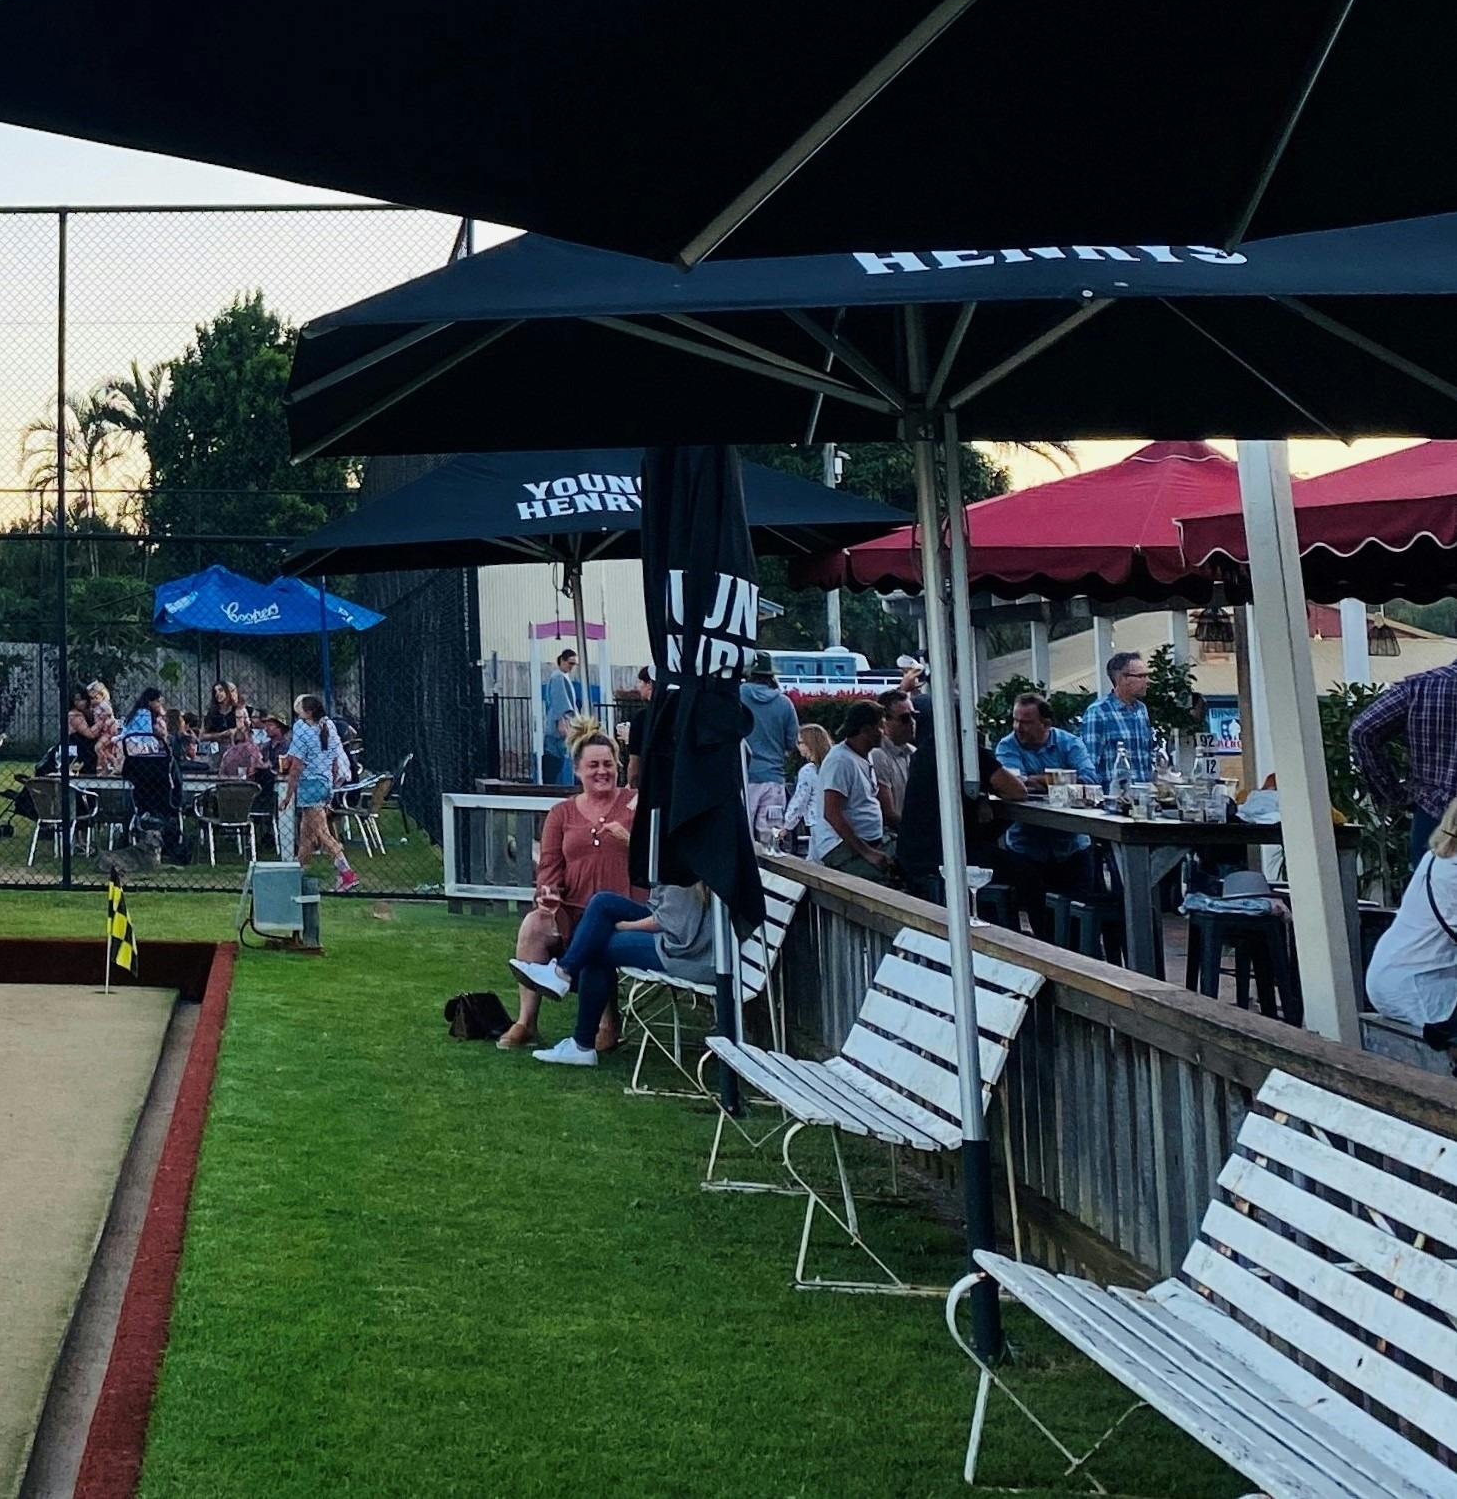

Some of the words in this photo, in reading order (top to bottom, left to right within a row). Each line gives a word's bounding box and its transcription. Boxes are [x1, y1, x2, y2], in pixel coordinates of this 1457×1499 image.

[516, 492, 642, 520] HENR
[1200, 734, 1215, 748] 92
[1206, 759, 1216, 774] 12
